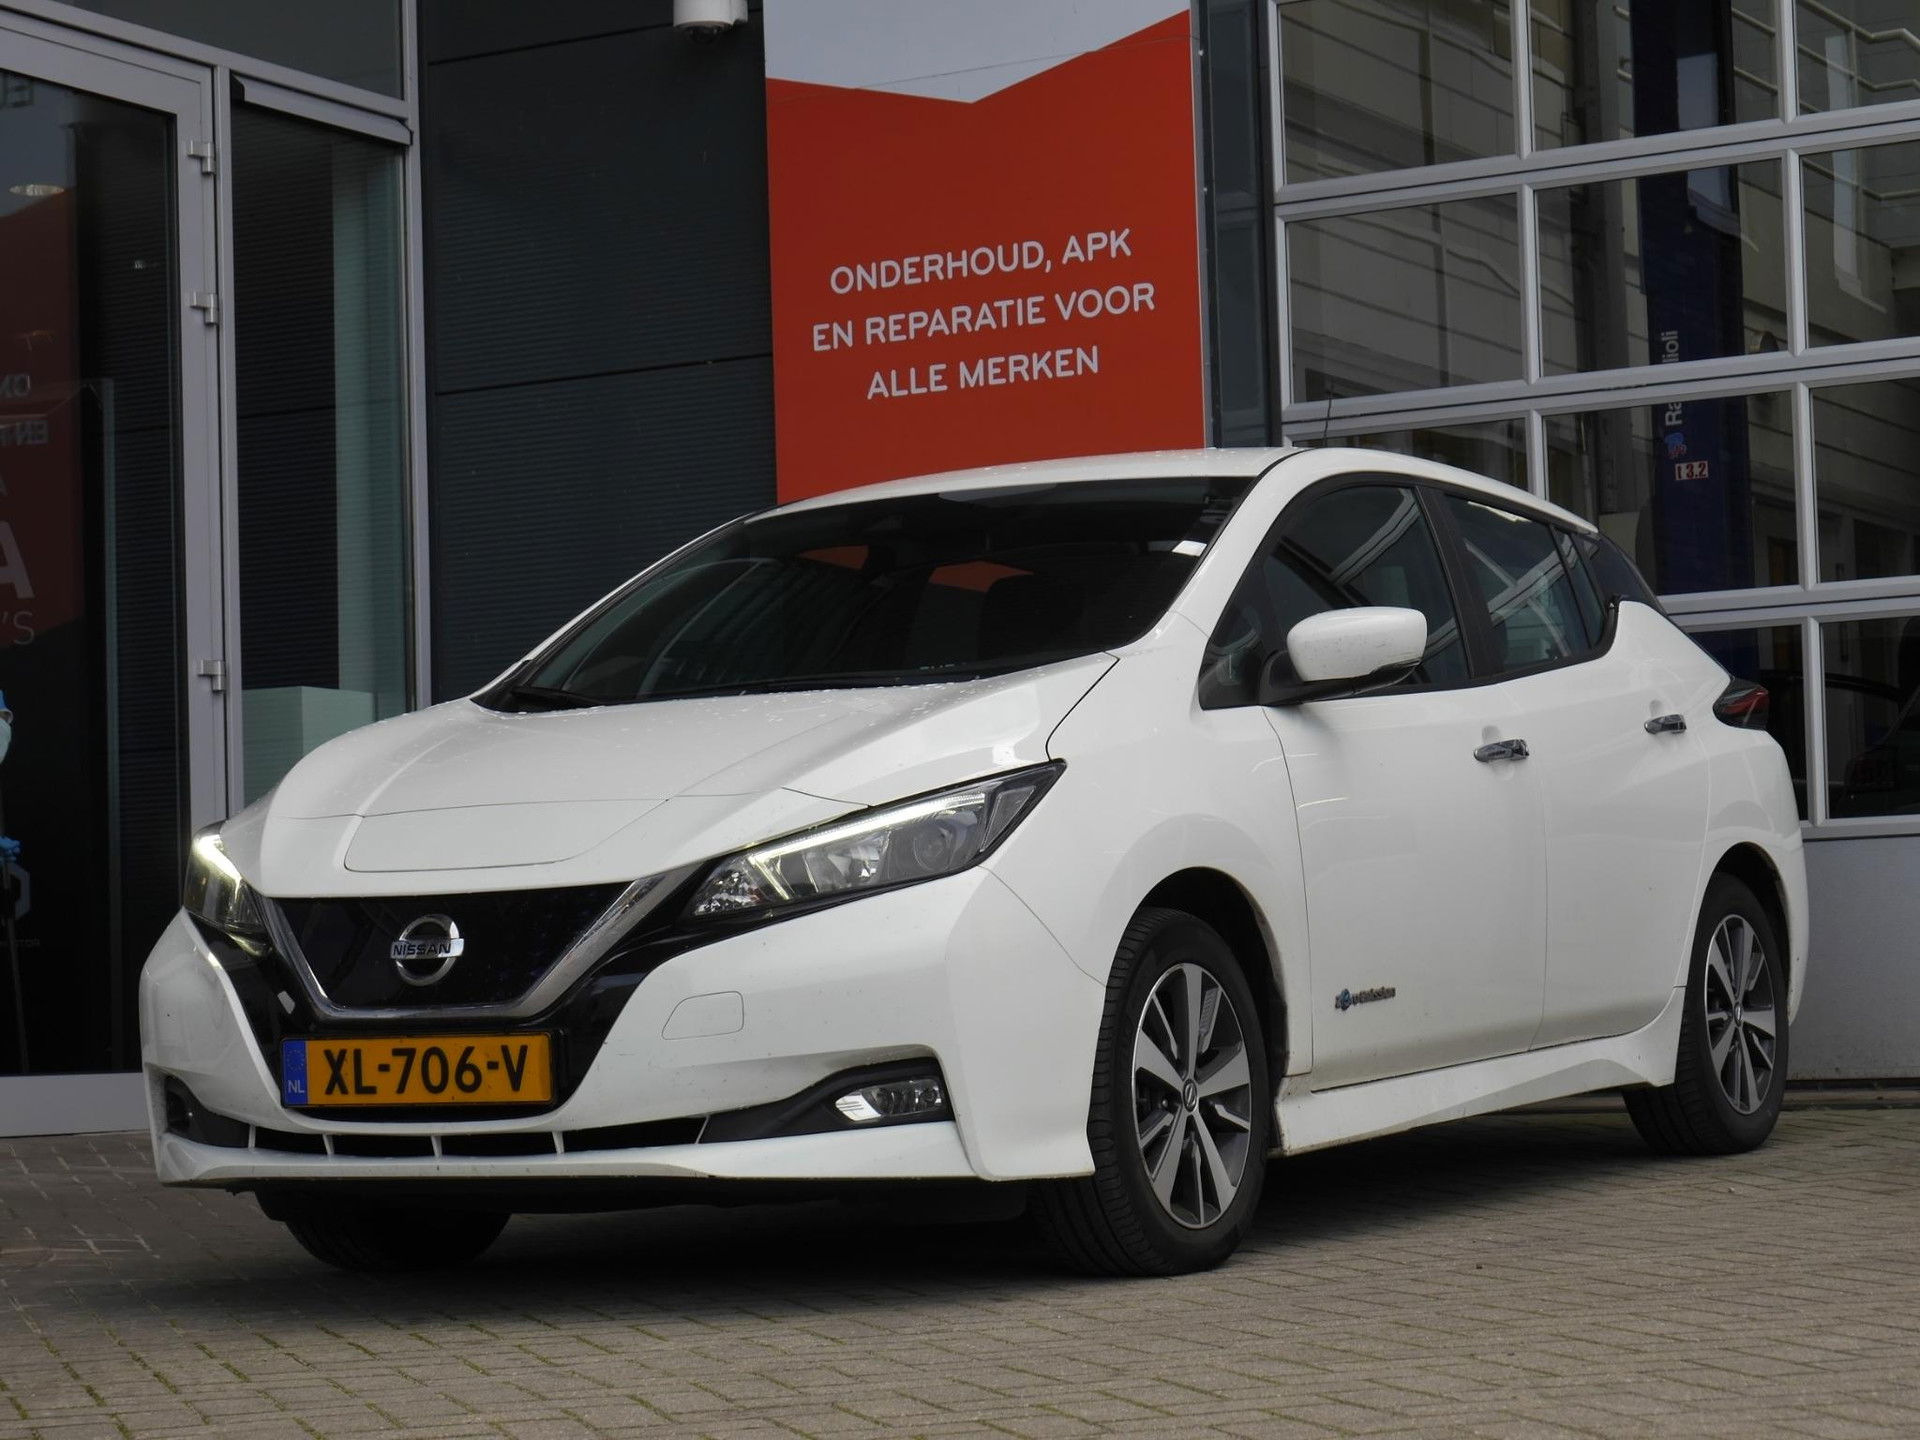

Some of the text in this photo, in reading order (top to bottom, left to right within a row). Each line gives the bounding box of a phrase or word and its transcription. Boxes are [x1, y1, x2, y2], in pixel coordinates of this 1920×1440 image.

[830, 228, 1132, 294] ONDERHOUD, APK
[813, 282, 1155, 351] EN REPARATIE VOOR
[867, 345, 1099, 400] ALLE MERKEN
[392, 942, 452, 957] NISSAN
[288, 1043, 529, 1097] NL XL-706-V
